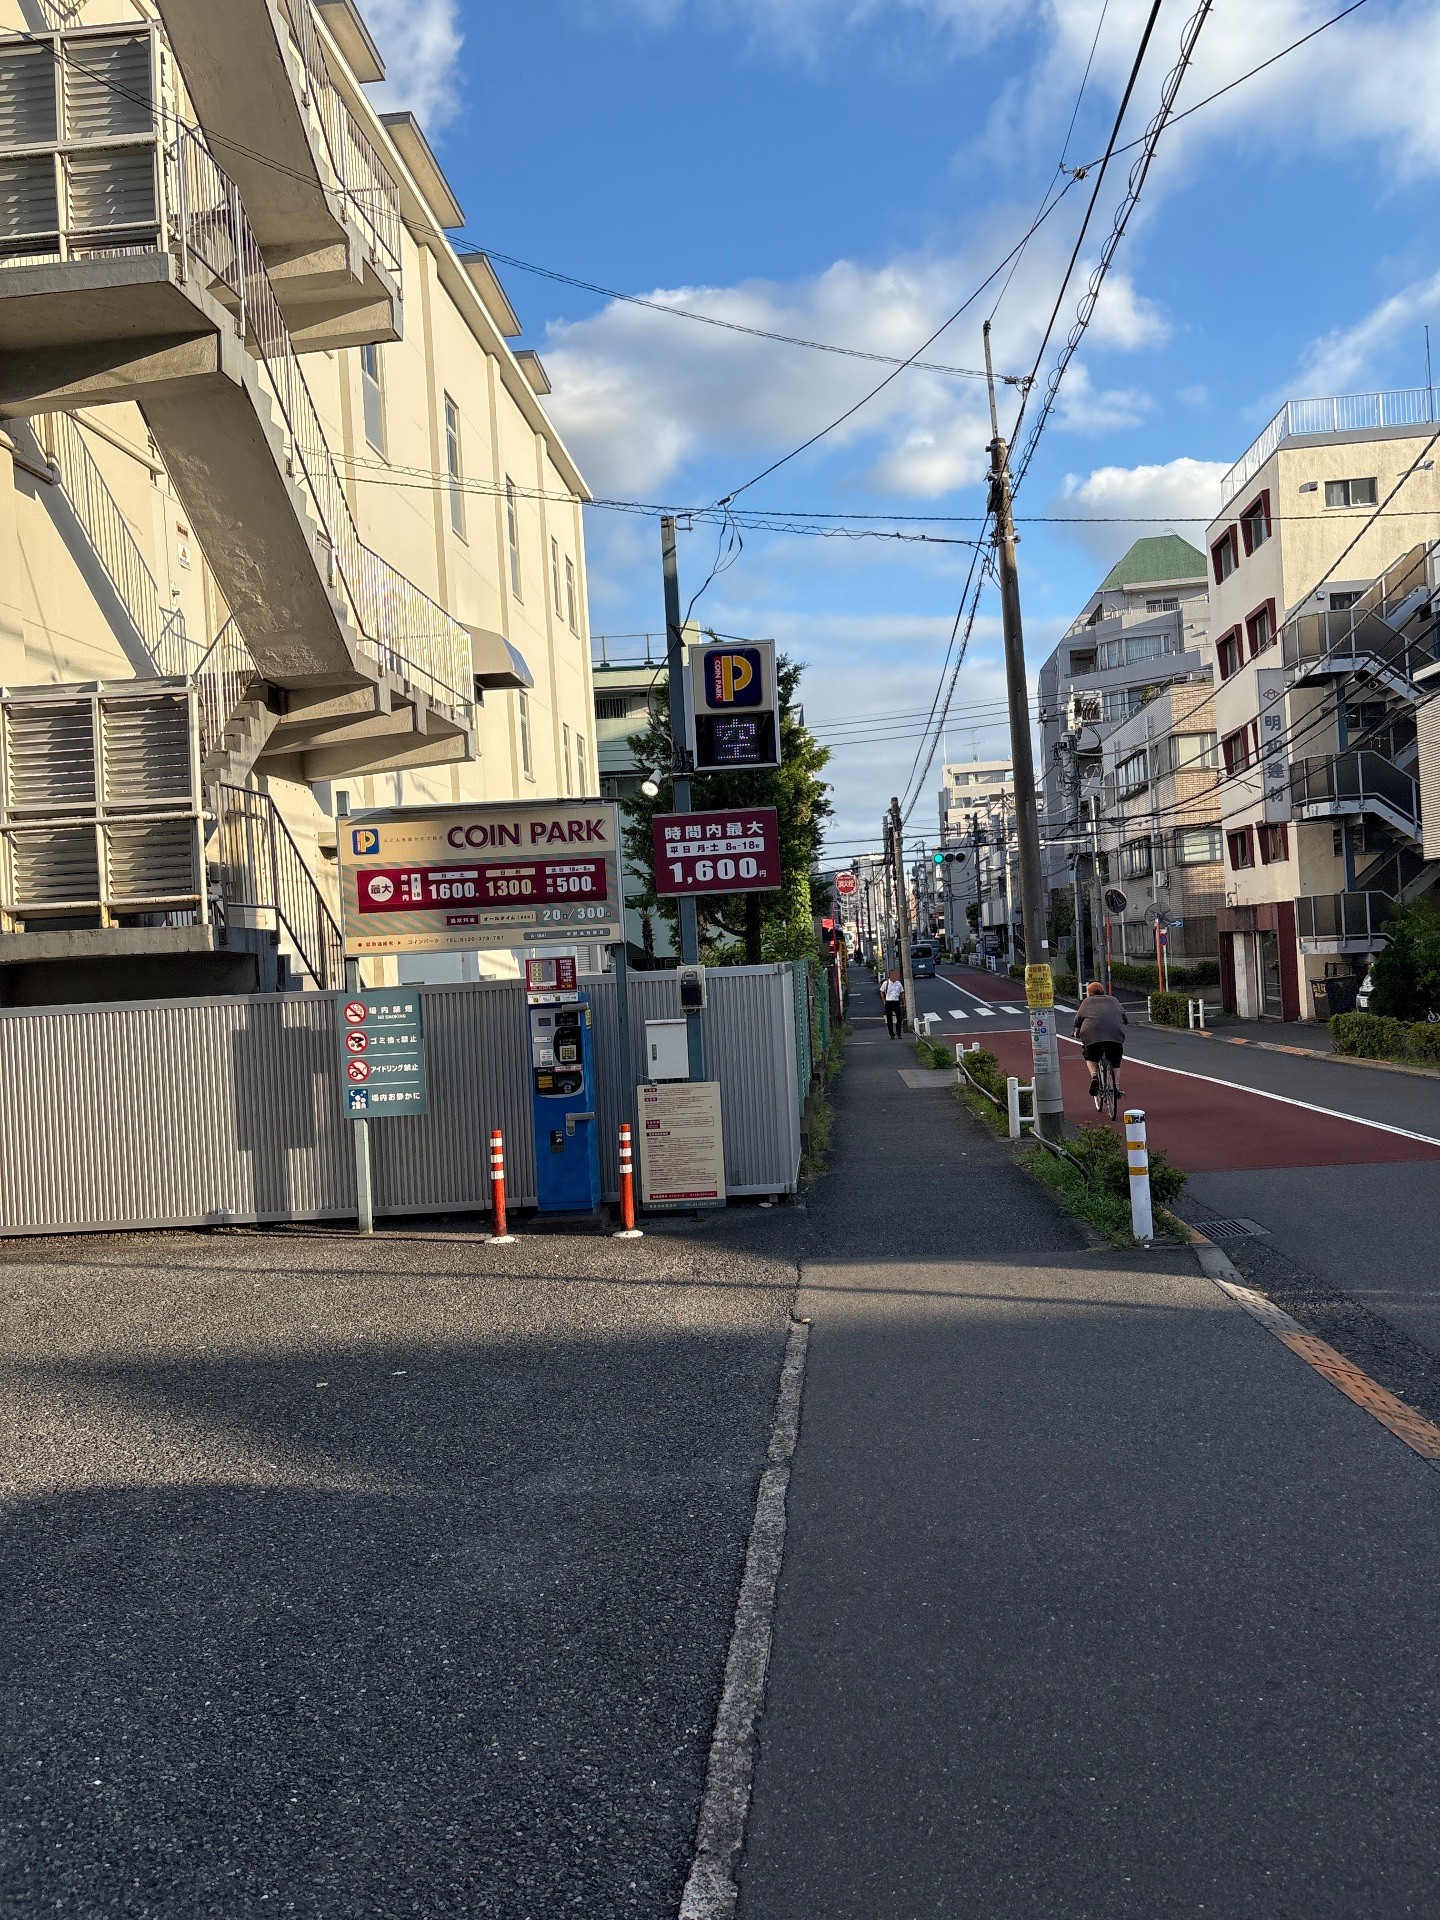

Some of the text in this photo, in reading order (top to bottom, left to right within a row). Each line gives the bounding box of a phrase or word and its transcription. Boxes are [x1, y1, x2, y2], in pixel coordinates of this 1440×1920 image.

[714, 659, 723, 702] COIN PARK
[447, 818, 606, 849] COIN PARK
[664, 821, 764, 840] 時間内最大
[669, 845, 691, 855] 平日
[668, 856, 767, 885] 1,600円
[370, 884, 392, 895] 最大
[368, 1004, 413, 1014] 場内禁煙
[370, 1035, 418, 1045] ゴミ捨て禁止
[370, 1063, 419, 1074] アイドリング禁止
[371, 1091, 421, 1102] 場内お静かに
